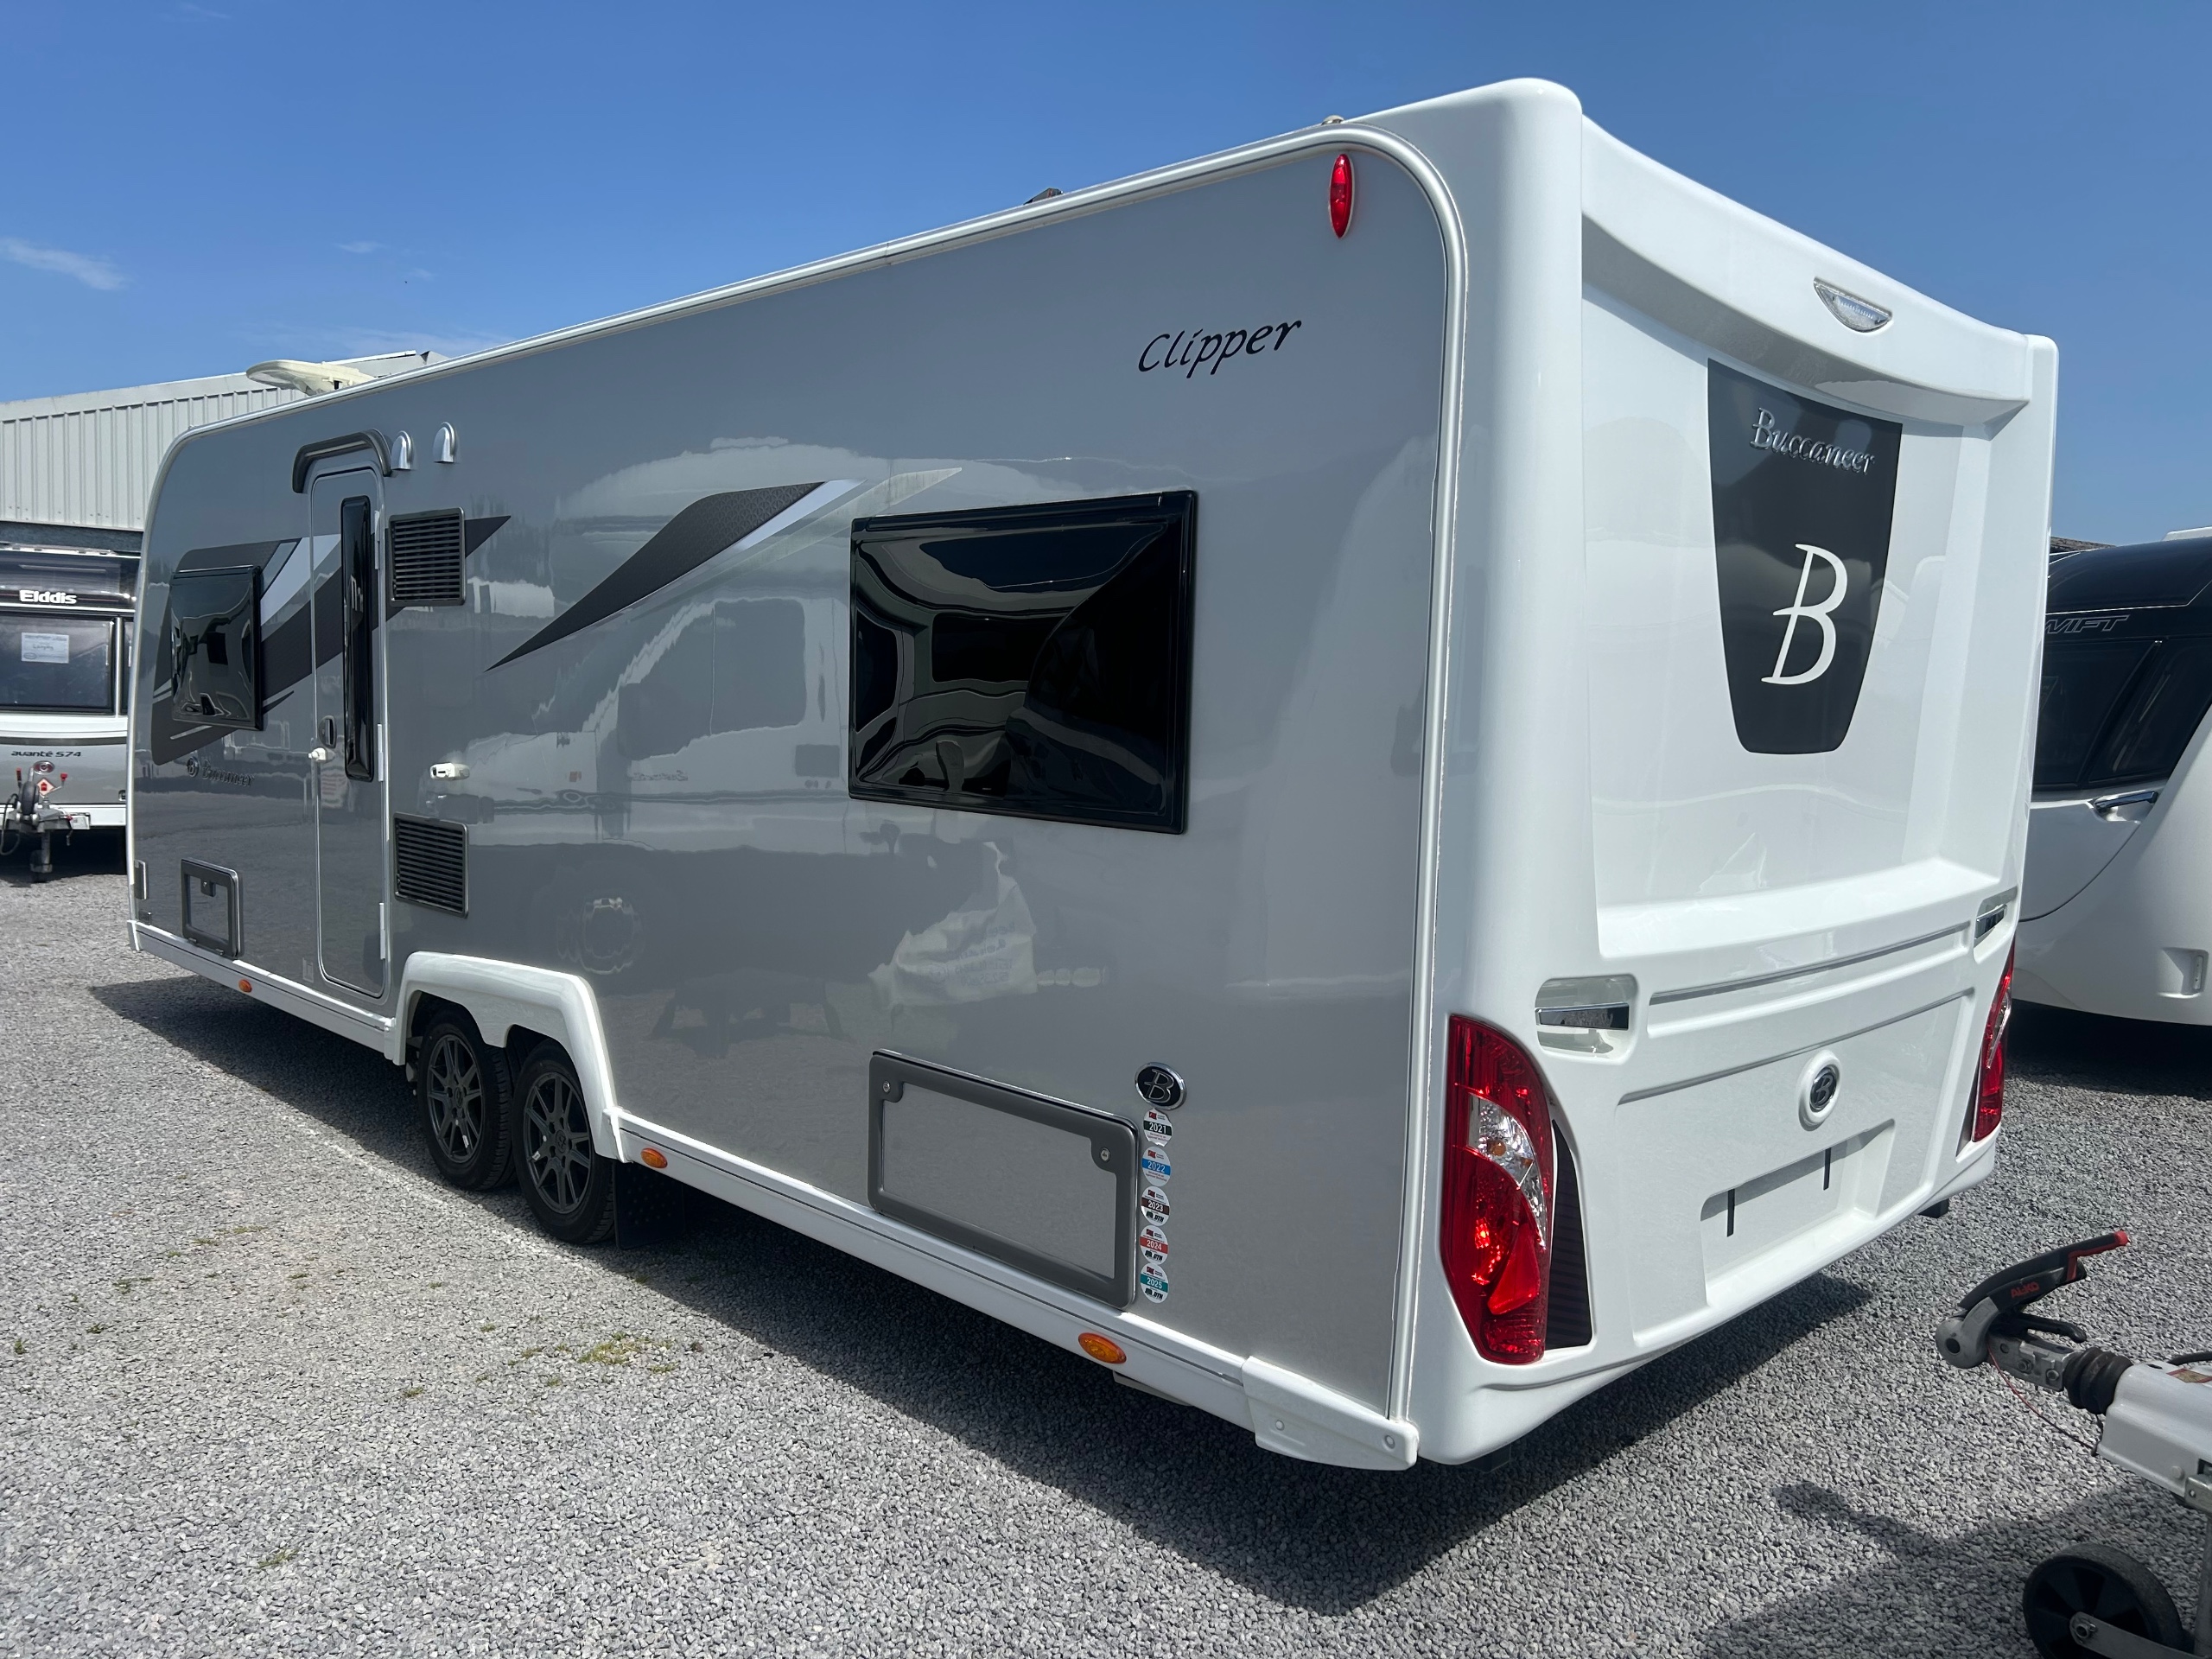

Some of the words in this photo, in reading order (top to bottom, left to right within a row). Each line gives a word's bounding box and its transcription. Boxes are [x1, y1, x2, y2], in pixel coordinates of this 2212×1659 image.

[1138, 319, 1302, 379] Clipper
[1749, 407, 1876, 476] Buccaneer
[19, 589, 78, 604] Elddis
[1761, 543, 1848, 685] B
[1148, 1122, 1167, 1135] 2021
[1147, 1160, 1166, 1173] 2022
[1147, 1199, 1164, 1212] 2023
[1147, 1239, 1162, 1251] 2024
[1147, 1277, 1163, 1289] 2025
